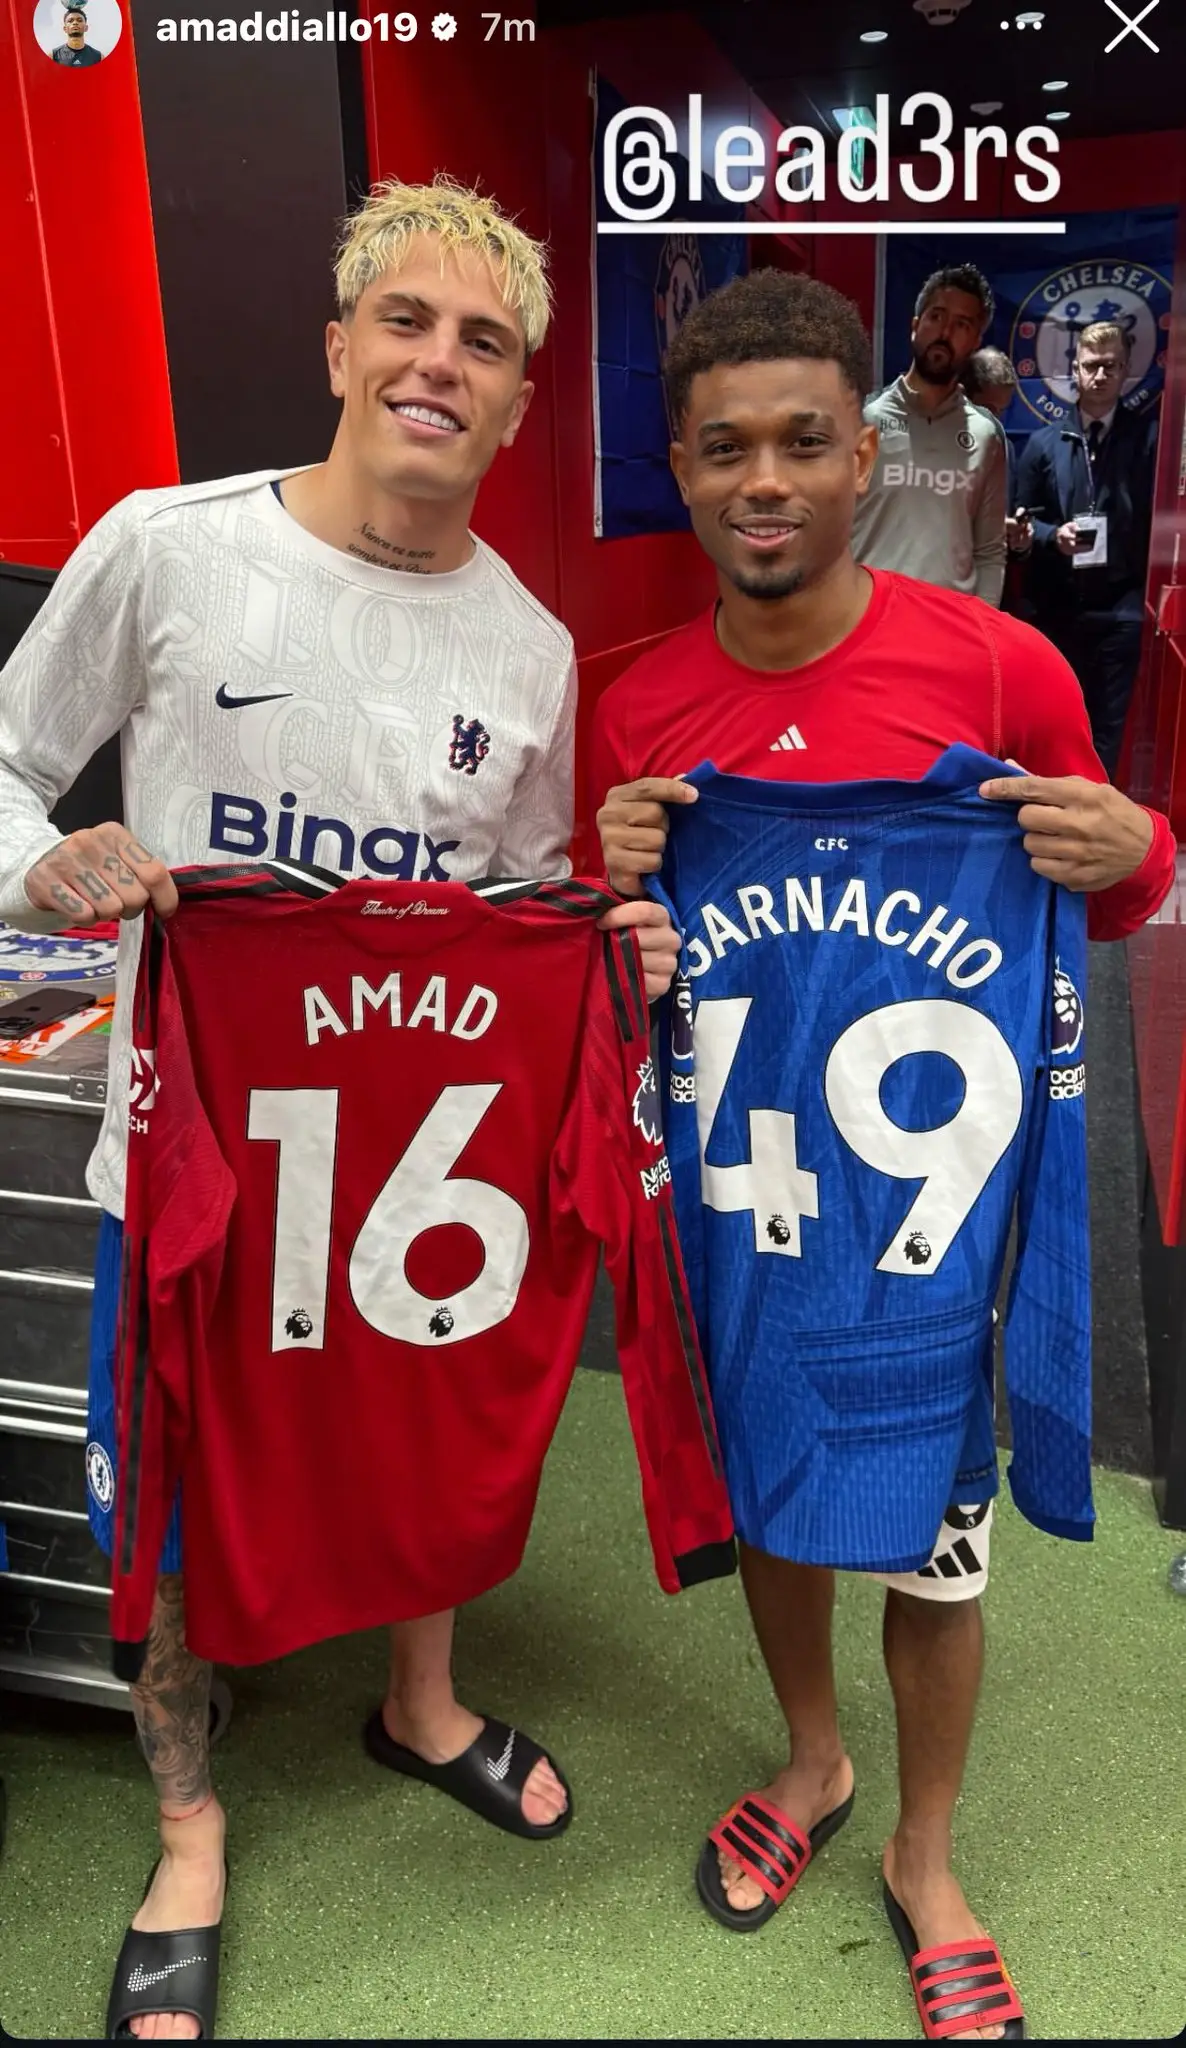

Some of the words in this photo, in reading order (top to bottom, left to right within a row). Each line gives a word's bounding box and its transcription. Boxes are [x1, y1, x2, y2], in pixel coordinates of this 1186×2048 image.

[1042, 265, 1157, 303] CHELSEA
[814, 837, 849, 852] CFC
[361, 899, 398, 916] Theatre
[395, 902, 414, 920] of
[410, 900, 450, 916] Dreams
[303, 971, 499, 1046] AMAD
[127, 1113, 149, 1134] CH
[693, 996, 1025, 1276] 49
[246, 1081, 531, 1353] 16
